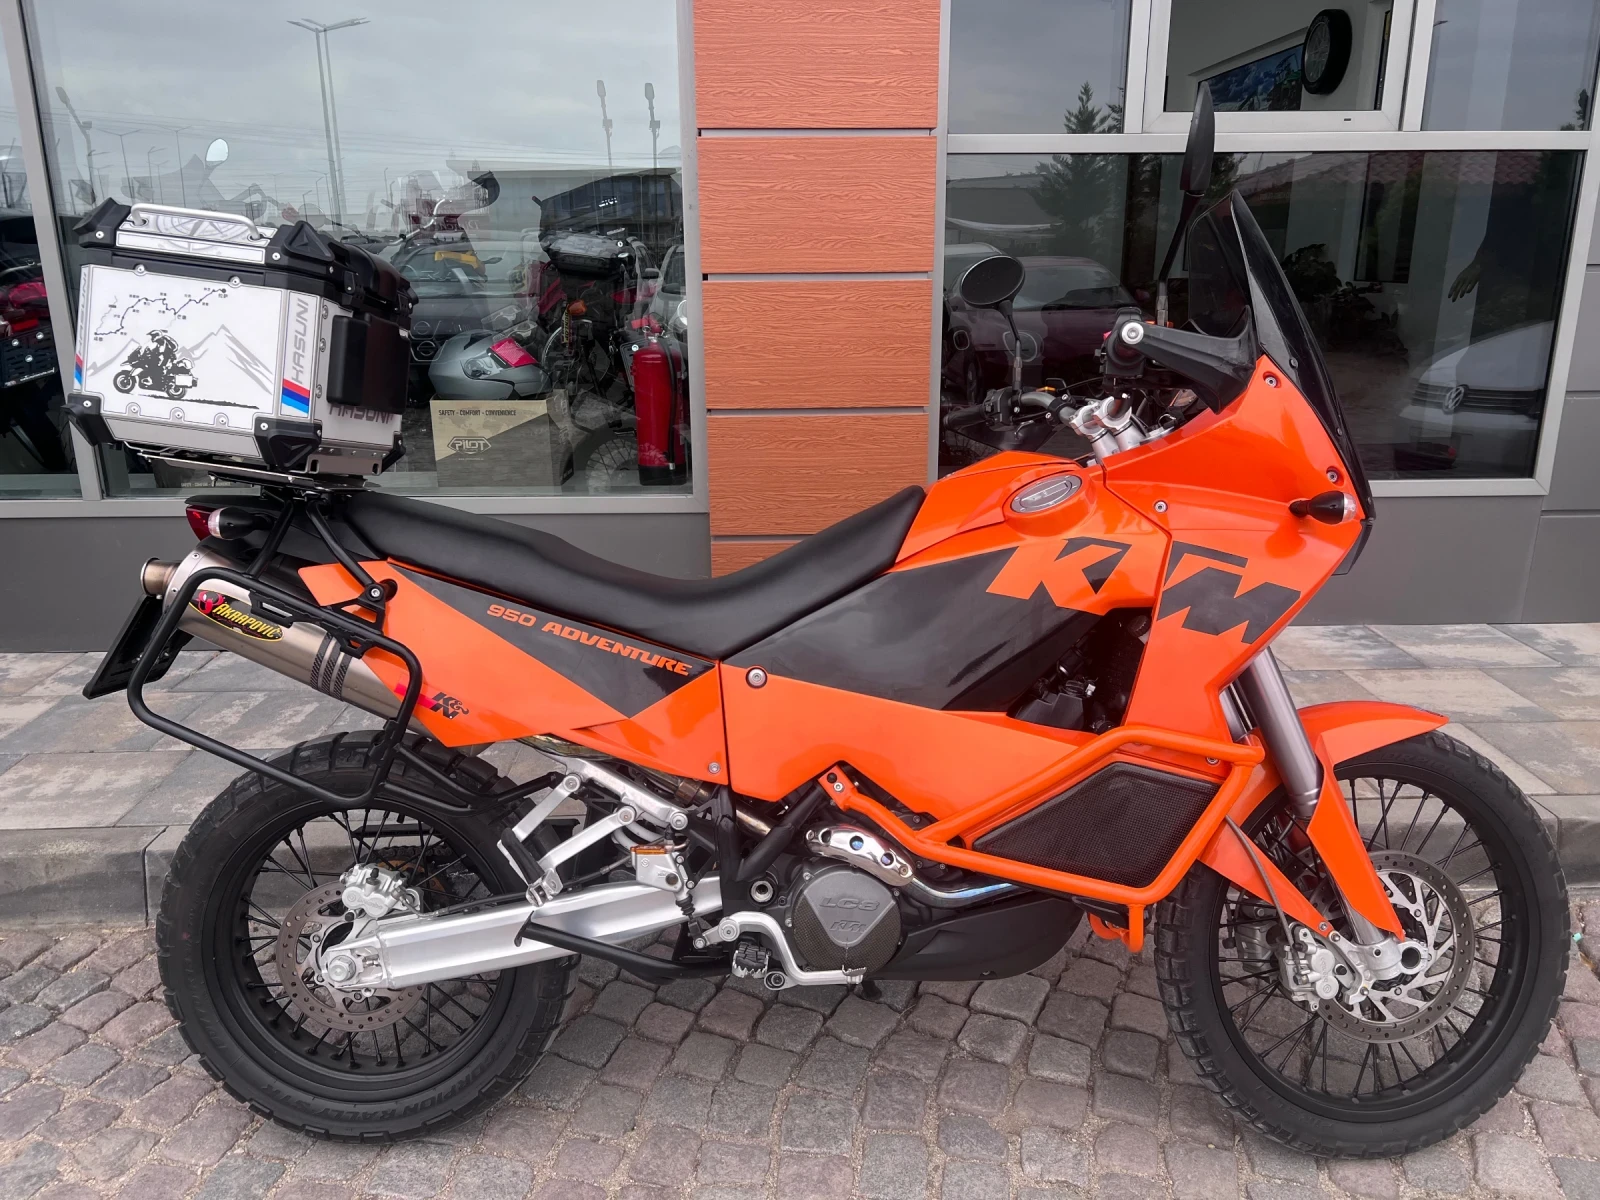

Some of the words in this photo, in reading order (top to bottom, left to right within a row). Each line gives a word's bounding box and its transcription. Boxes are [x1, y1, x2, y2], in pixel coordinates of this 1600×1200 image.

[291, 298, 309, 384] KASUNI
[453, 438, 486, 451] PILOT
[985, 536, 1301, 644] KTM
[486, 604, 538, 627] 950
[541, 621, 693, 676] ADVENTURE
[429, 691, 470, 720] K&N
[819, 896, 881, 912] LC8
[318, 1104, 401, 1122] RALLY
